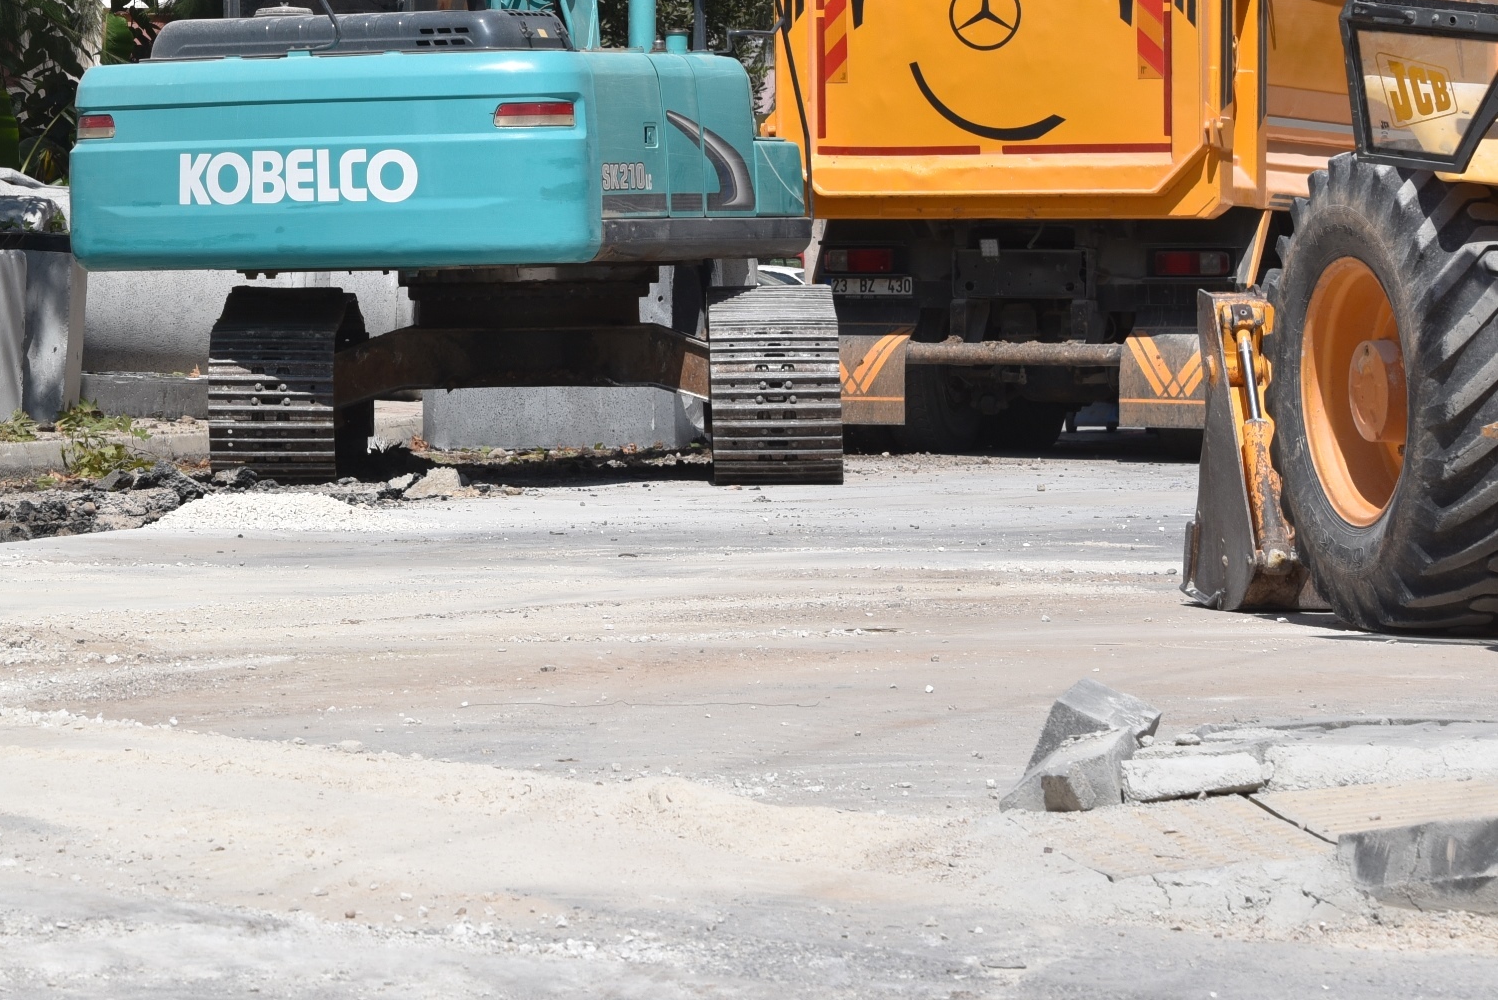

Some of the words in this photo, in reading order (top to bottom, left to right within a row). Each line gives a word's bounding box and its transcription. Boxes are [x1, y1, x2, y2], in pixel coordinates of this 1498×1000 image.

[1387, 59, 1452, 123] JCB
[179, 148, 419, 206] KOBELCO
[832, 279, 848, 293] 23
[859, 279, 875, 293] BZ
[887, 279, 911, 293] 430
